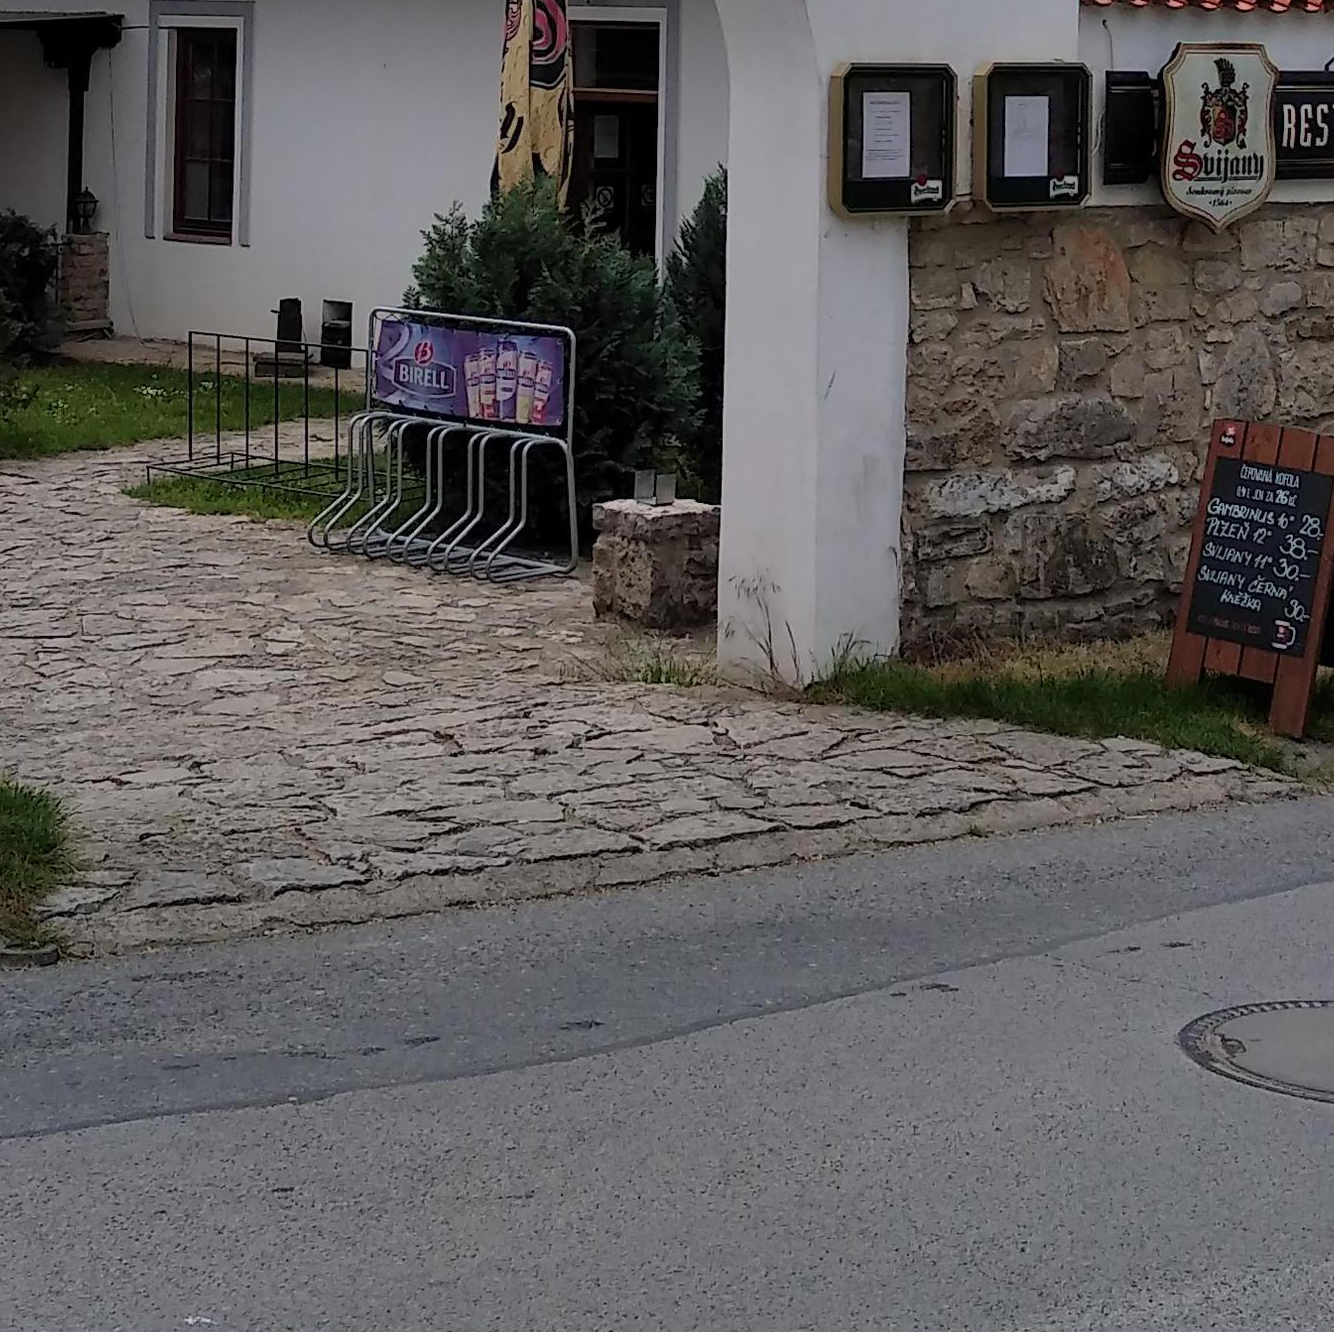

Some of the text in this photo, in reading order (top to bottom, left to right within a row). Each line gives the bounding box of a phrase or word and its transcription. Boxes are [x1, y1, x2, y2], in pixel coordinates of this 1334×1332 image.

[1172, 139, 1264, 184] Svijany
[399, 362, 450, 390] BIRELL
[1275, 488, 1290, 505] 26
[1207, 497, 1275, 525] GAMBRINUS
[1202, 541, 1253, 566] SVIJANY
[1197, 565, 1246, 589] SVIJANY
